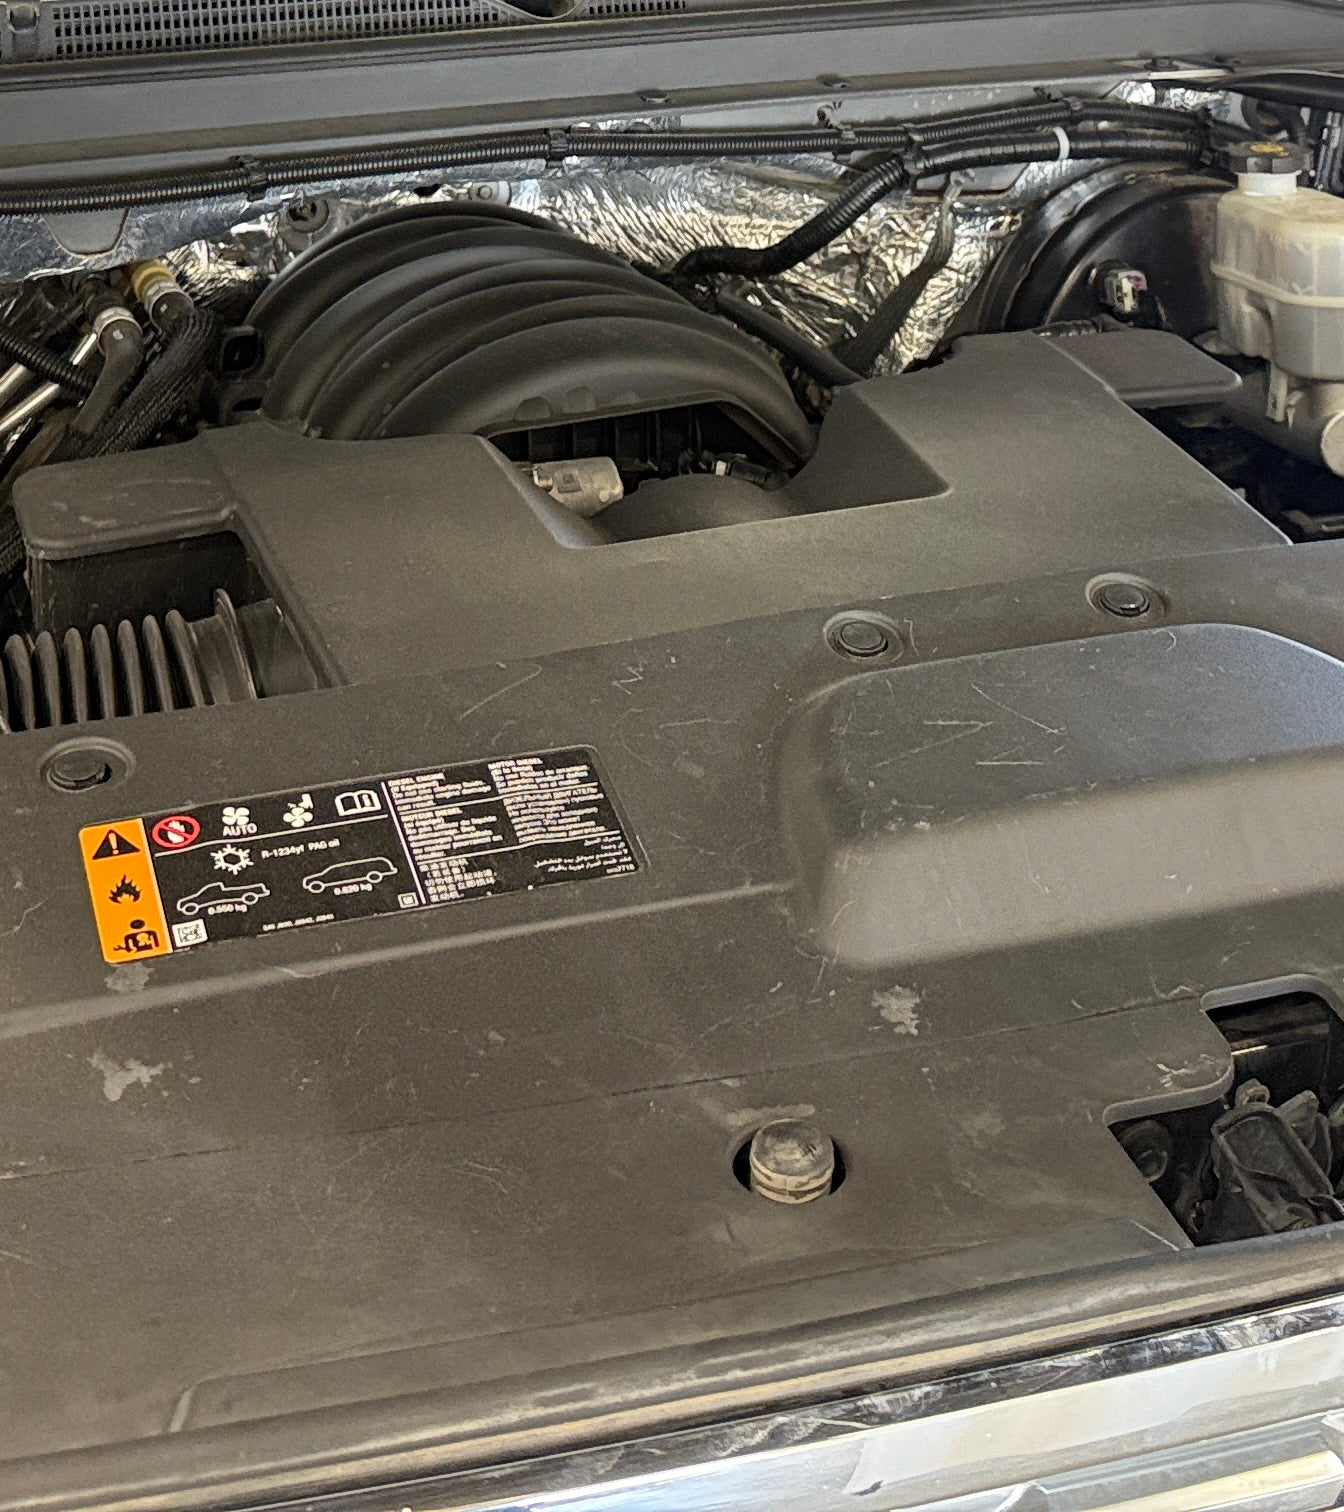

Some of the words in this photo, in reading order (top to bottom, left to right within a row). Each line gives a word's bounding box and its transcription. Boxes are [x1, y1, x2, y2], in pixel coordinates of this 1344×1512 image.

[222, 822, 257, 836] AUTO
[261, 842, 305, 860] R-1234yf
[308, 840, 327, 851] PAG
[328, 838, 340, 849] oil
